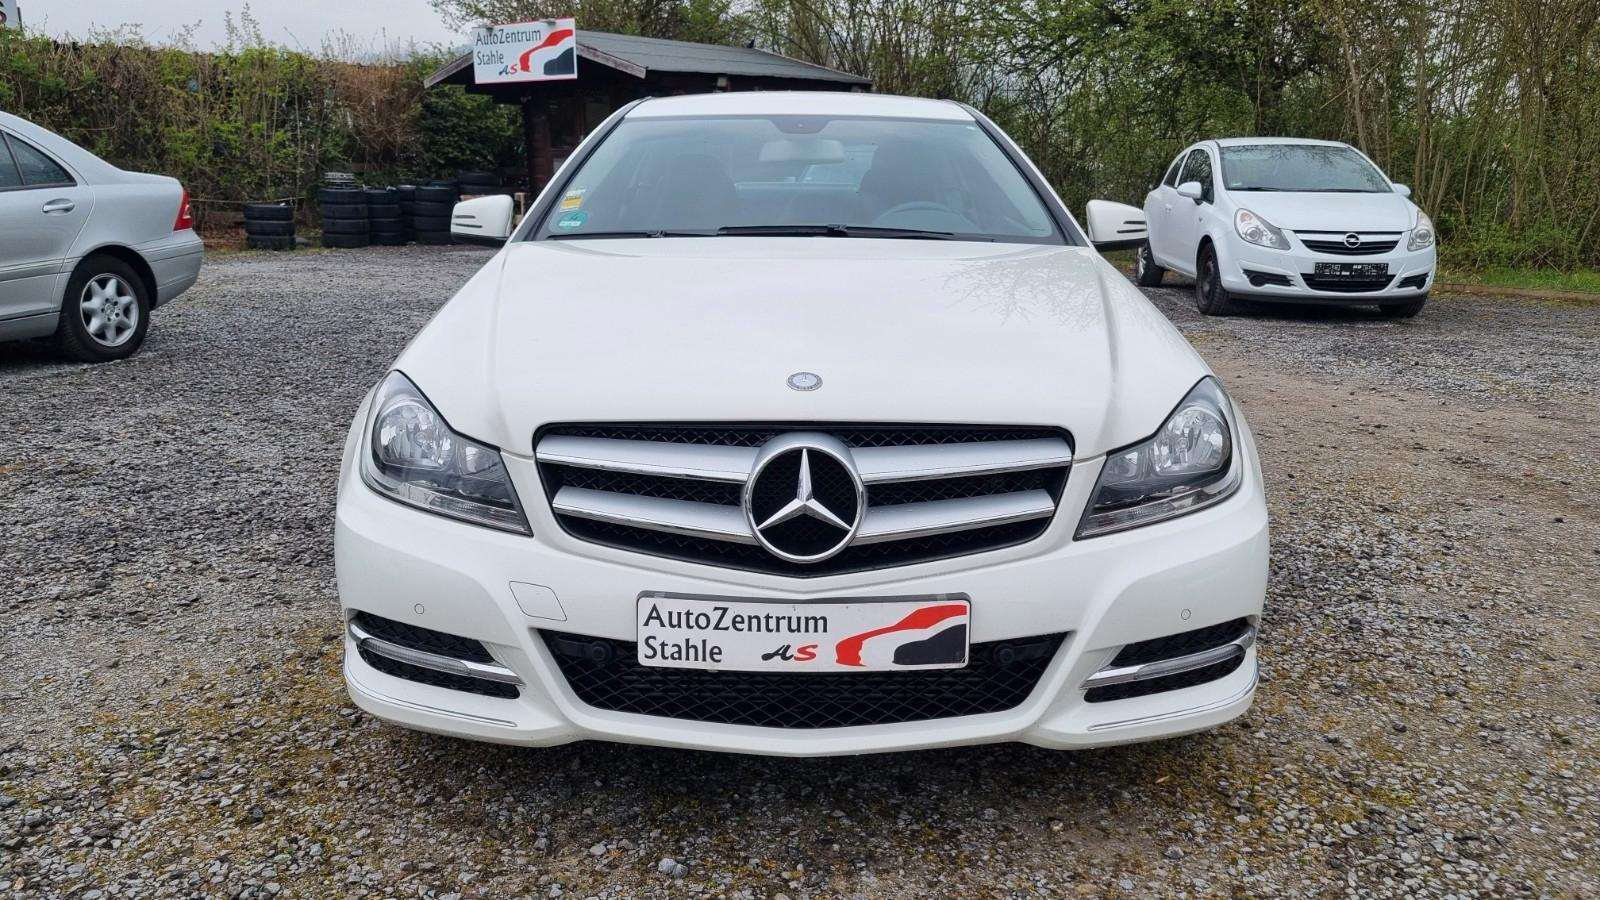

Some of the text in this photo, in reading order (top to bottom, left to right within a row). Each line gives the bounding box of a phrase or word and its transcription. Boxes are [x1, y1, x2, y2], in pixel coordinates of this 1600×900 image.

[475, 29, 541, 46] AutoZentrum
[477, 50, 505, 65] Stahle
[643, 603, 828, 633] AutoZentrum
[644, 635, 723, 663] Stahle
